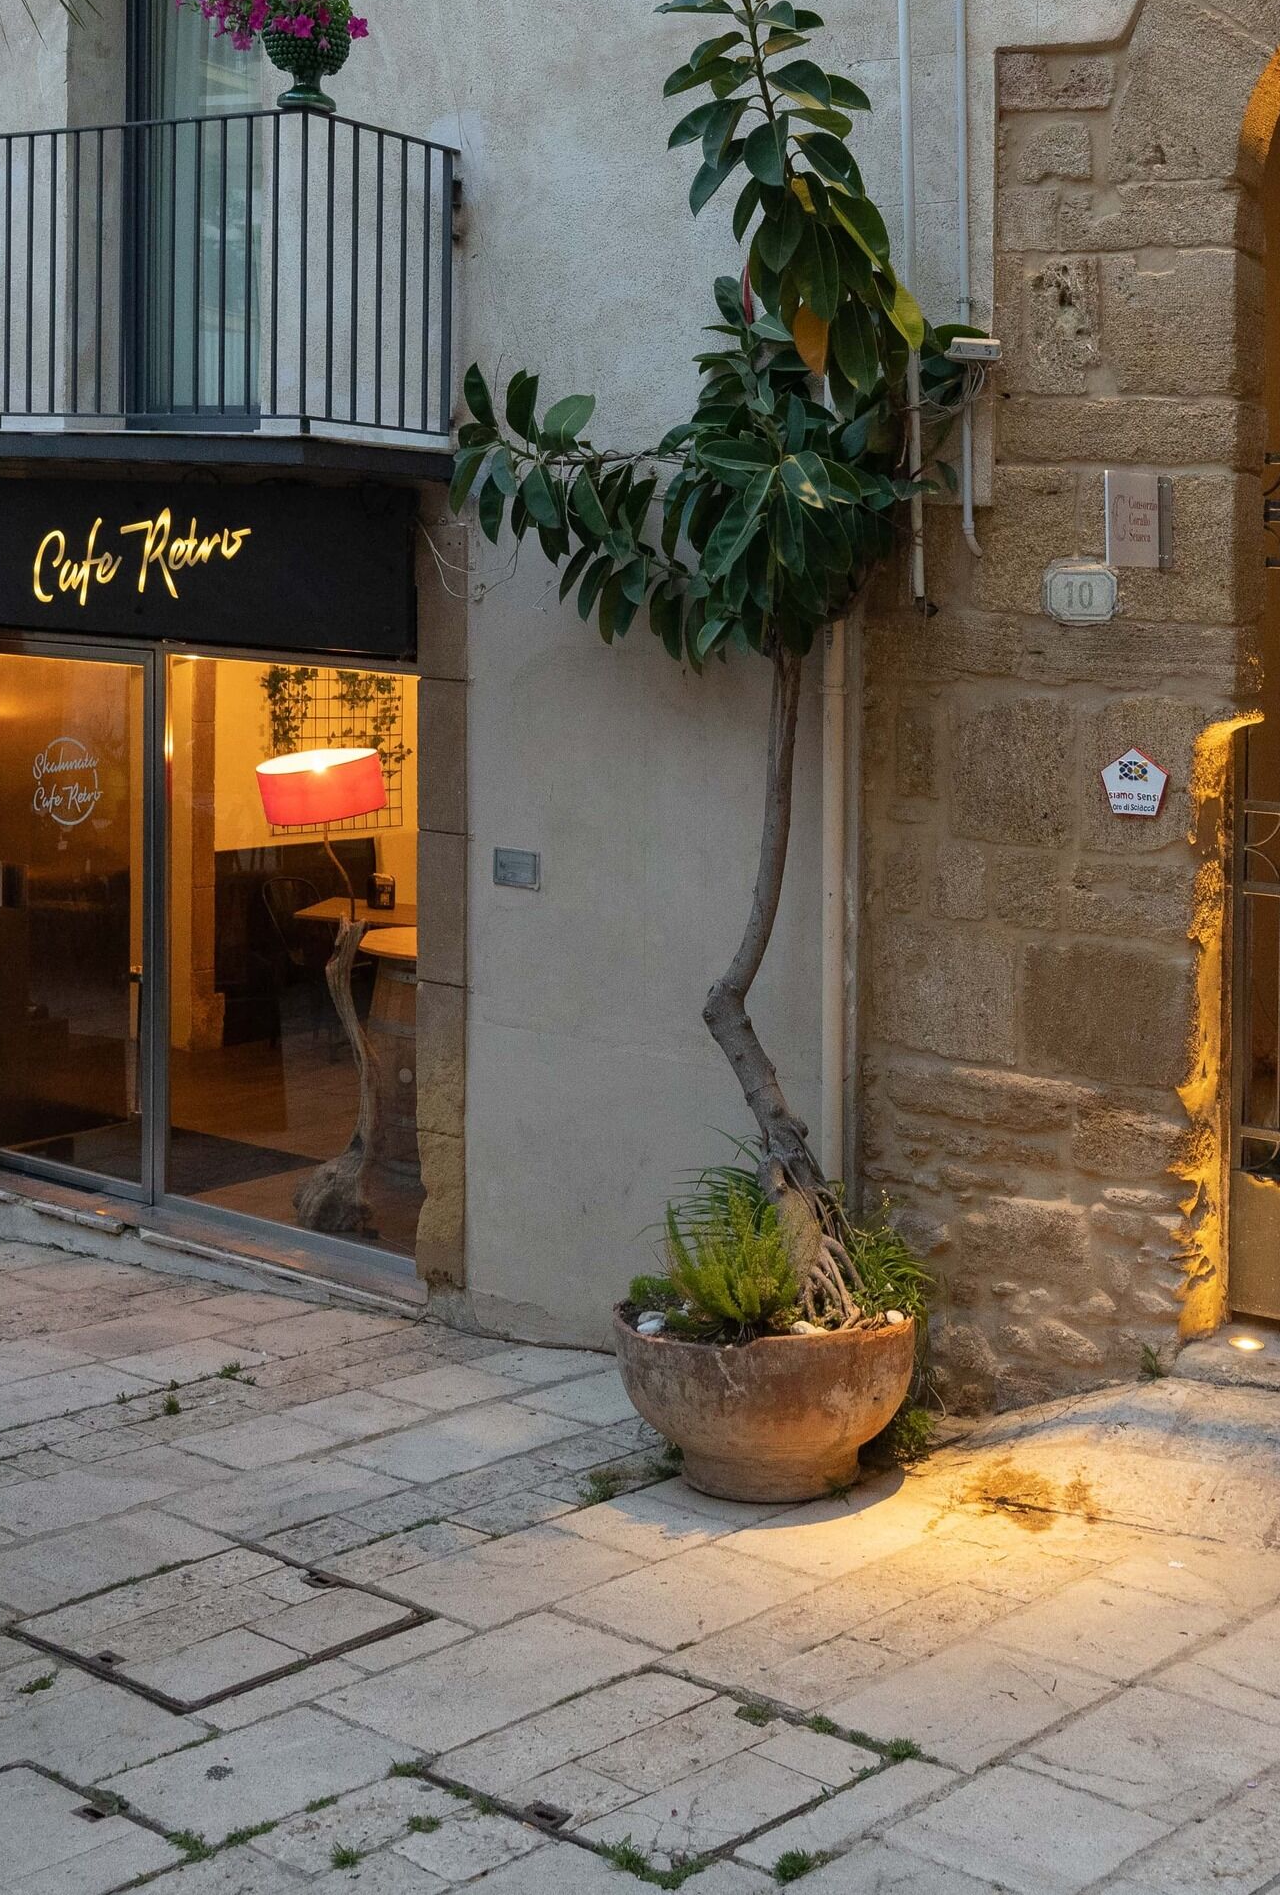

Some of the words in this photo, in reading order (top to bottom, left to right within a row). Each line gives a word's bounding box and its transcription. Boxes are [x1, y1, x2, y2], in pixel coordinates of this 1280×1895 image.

[1128, 496, 1158, 511] Consorzio
[1128, 512, 1151, 526] Corallo
[1128, 528, 1152, 543] Sciacca
[33, 518, 123, 606] Cafe
[120, 507, 252, 599] Retro
[1063, 580, 1094, 610] 10
[33, 783, 63, 813] Cafe
[62, 782, 104, 813] Retro
[1130, 803, 1155, 812] Sciacca
